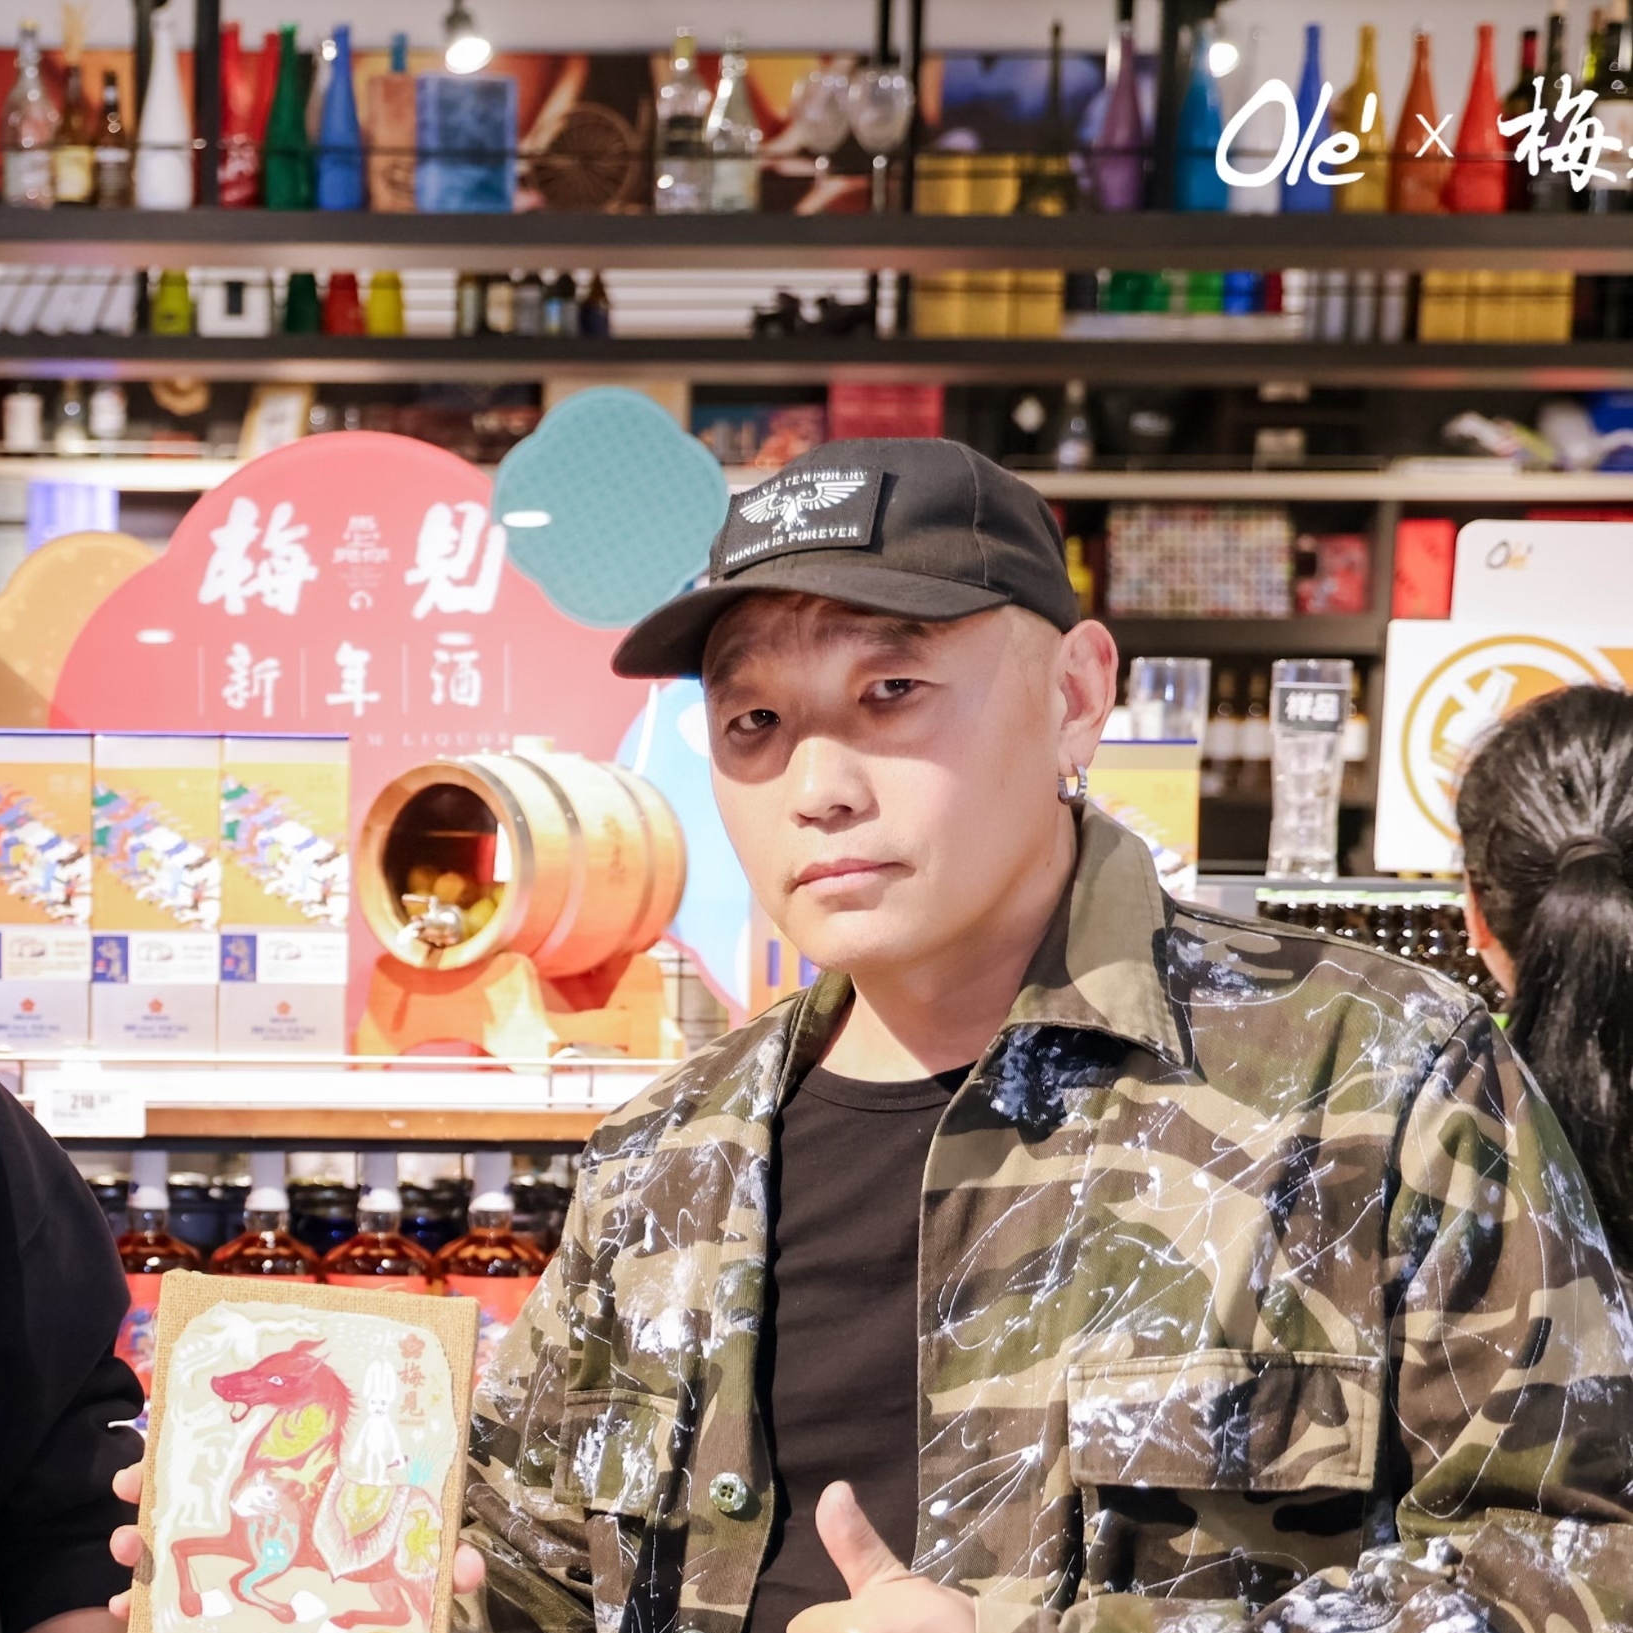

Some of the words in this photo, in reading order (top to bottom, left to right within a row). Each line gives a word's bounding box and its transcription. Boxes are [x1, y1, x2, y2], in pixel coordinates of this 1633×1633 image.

[785, 471, 868, 488] TEMPORARY
[725, 539, 769, 565] HONOR
[772, 535, 783, 547] IS
[788, 527, 858, 543] FOREVER
